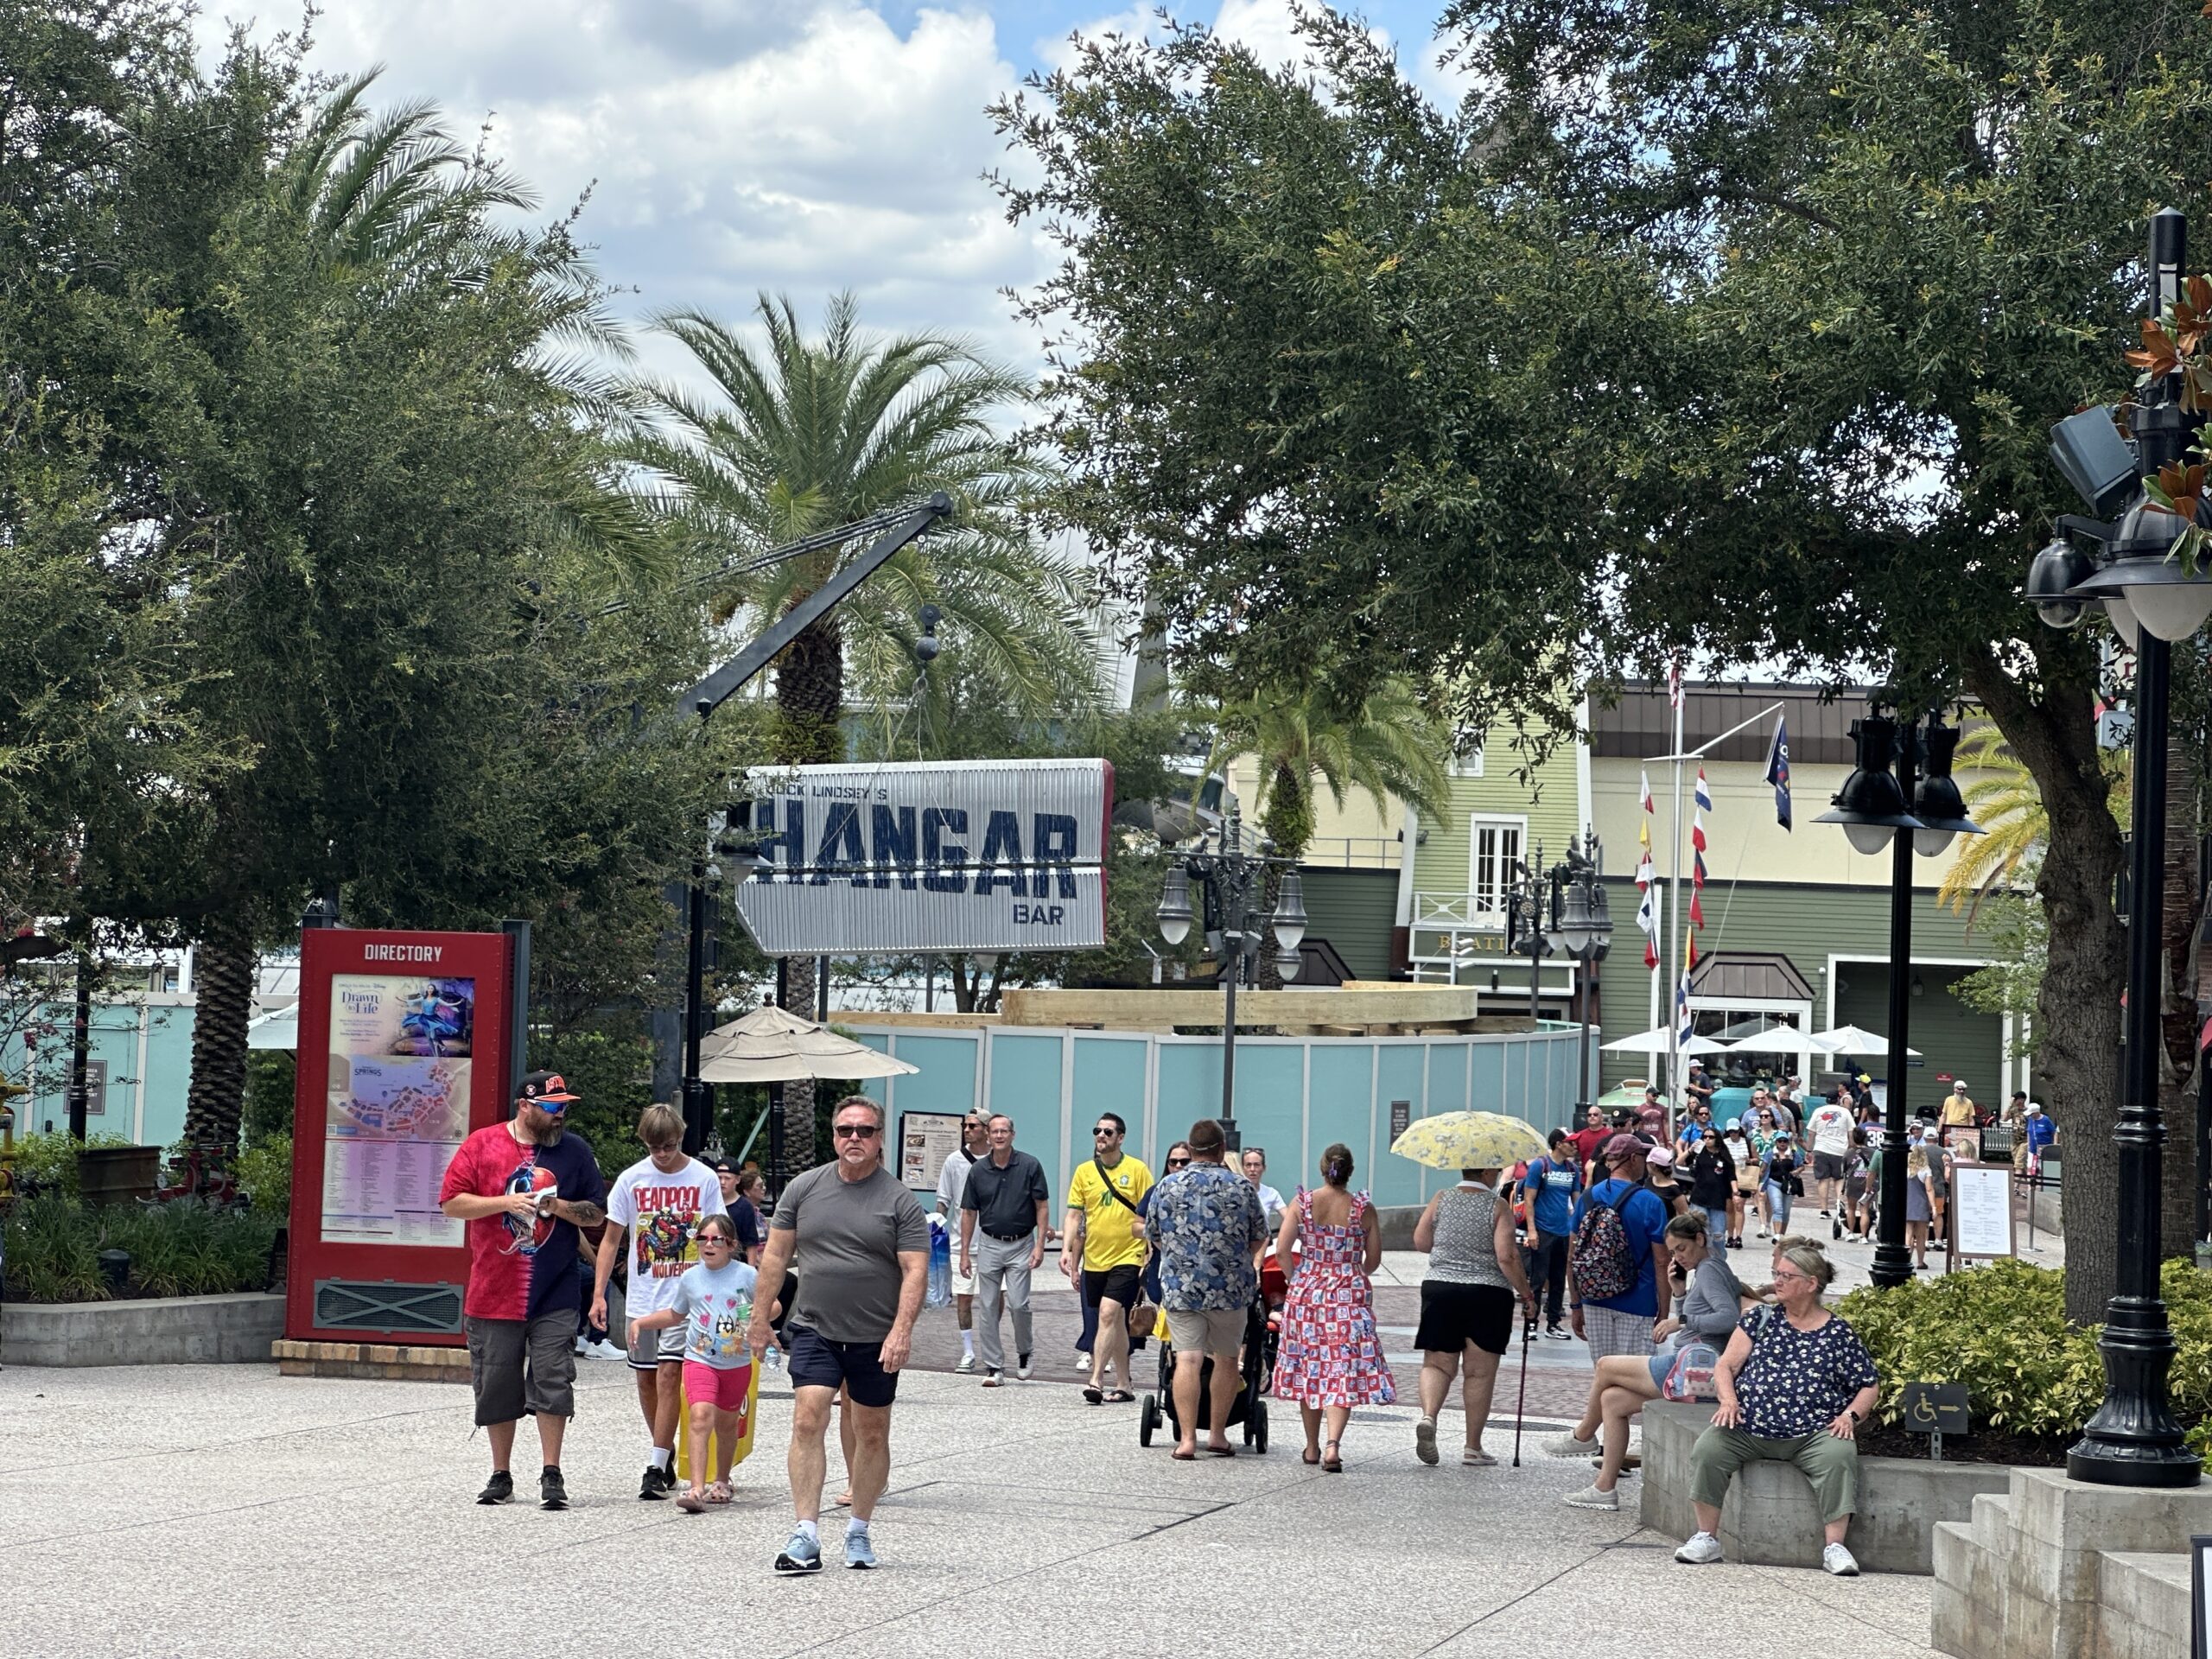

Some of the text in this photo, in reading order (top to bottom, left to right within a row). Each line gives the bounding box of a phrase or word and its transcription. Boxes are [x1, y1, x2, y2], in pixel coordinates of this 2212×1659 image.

[813, 785, 887, 800] LINDSEY'S
[757, 798, 1077, 899] HANGAR
[1014, 904, 1065, 926] BAR
[365, 944, 442, 963] DIRECTORY
[354, 1068, 382, 1077] SPRINGS
[633, 1186, 701, 1212] DEADPOOL
